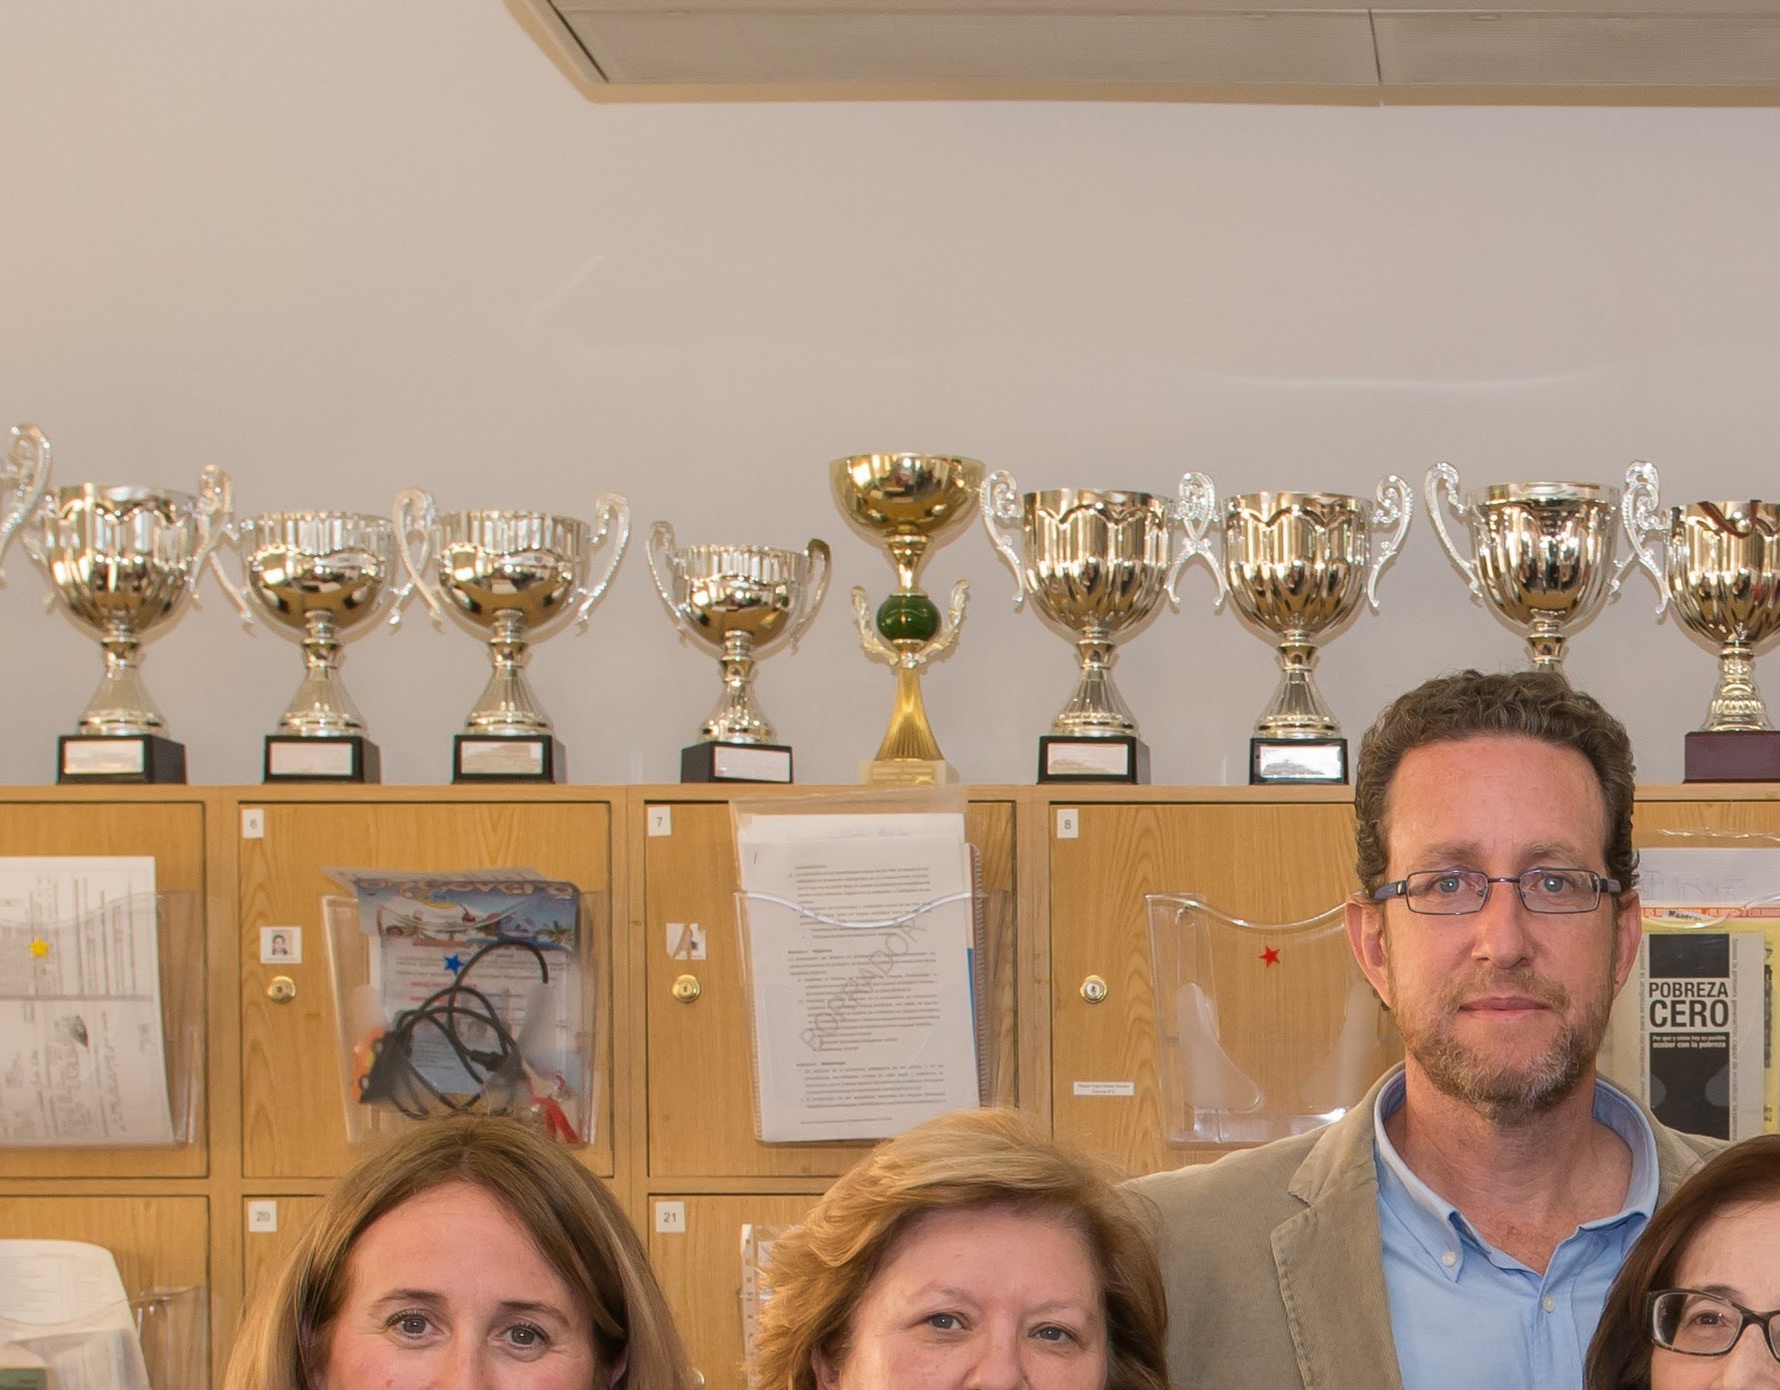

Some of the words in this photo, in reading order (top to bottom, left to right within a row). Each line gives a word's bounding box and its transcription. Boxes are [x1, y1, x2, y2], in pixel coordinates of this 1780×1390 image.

[249, 818, 258, 829] 6
[656, 816, 664, 827] 7
[1064, 819, 1072, 830] 8
[800, 917, 927, 1052] BORRADOR
[1649, 982, 1729, 998] POBREZA
[1649, 999, 1729, 1028] CERO
[256, 1211, 270, 1222] 20
[663, 1211, 676, 1222] 21
